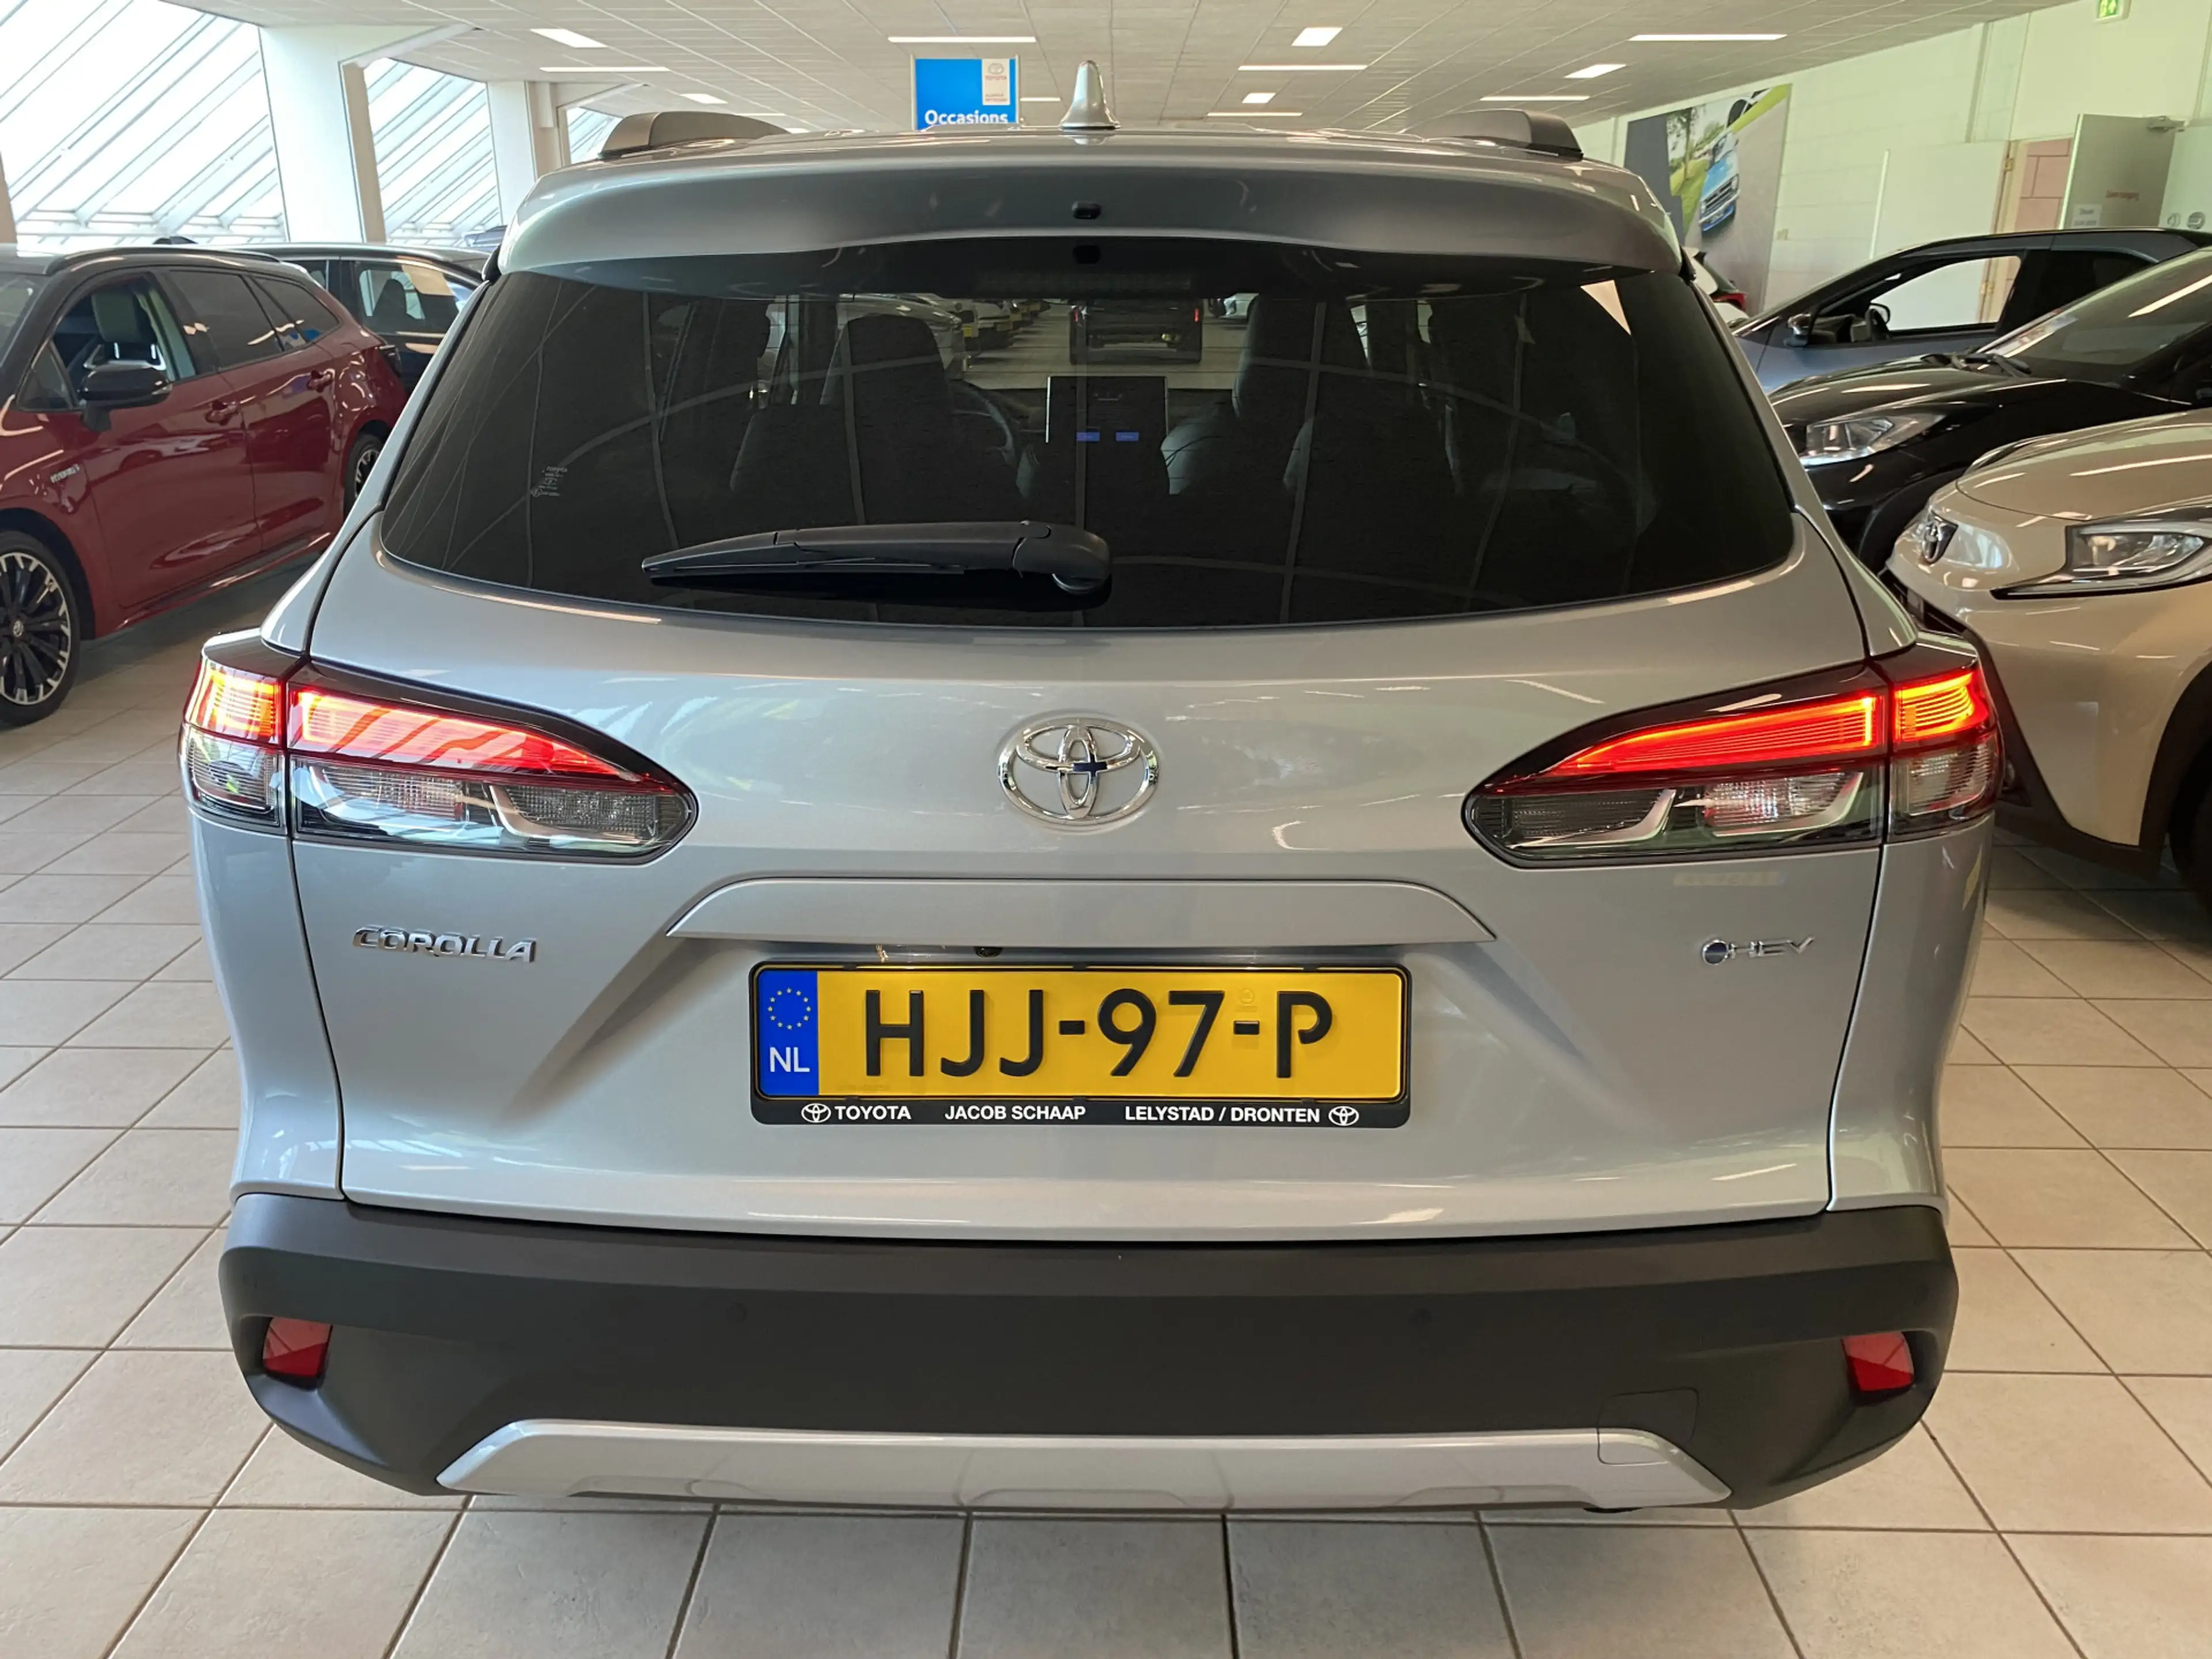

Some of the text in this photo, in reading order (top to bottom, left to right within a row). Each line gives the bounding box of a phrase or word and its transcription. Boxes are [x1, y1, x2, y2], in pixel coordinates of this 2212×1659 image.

[925, 109, 1008, 124] Occasions
[352, 924, 537, 963] COROLLA
[865, 988, 1333, 1078] HJJ-97-P
[769, 1047, 810, 1073] NL
[834, 1105, 911, 1120] TOYOTA
[945, 1105, 1006, 1120] JACOB
[1011, 1105, 1086, 1120] SCHAAP
[1125, 1106, 1214, 1121] LELYSTAD
[1230, 1107, 1320, 1123] DRONTEN
